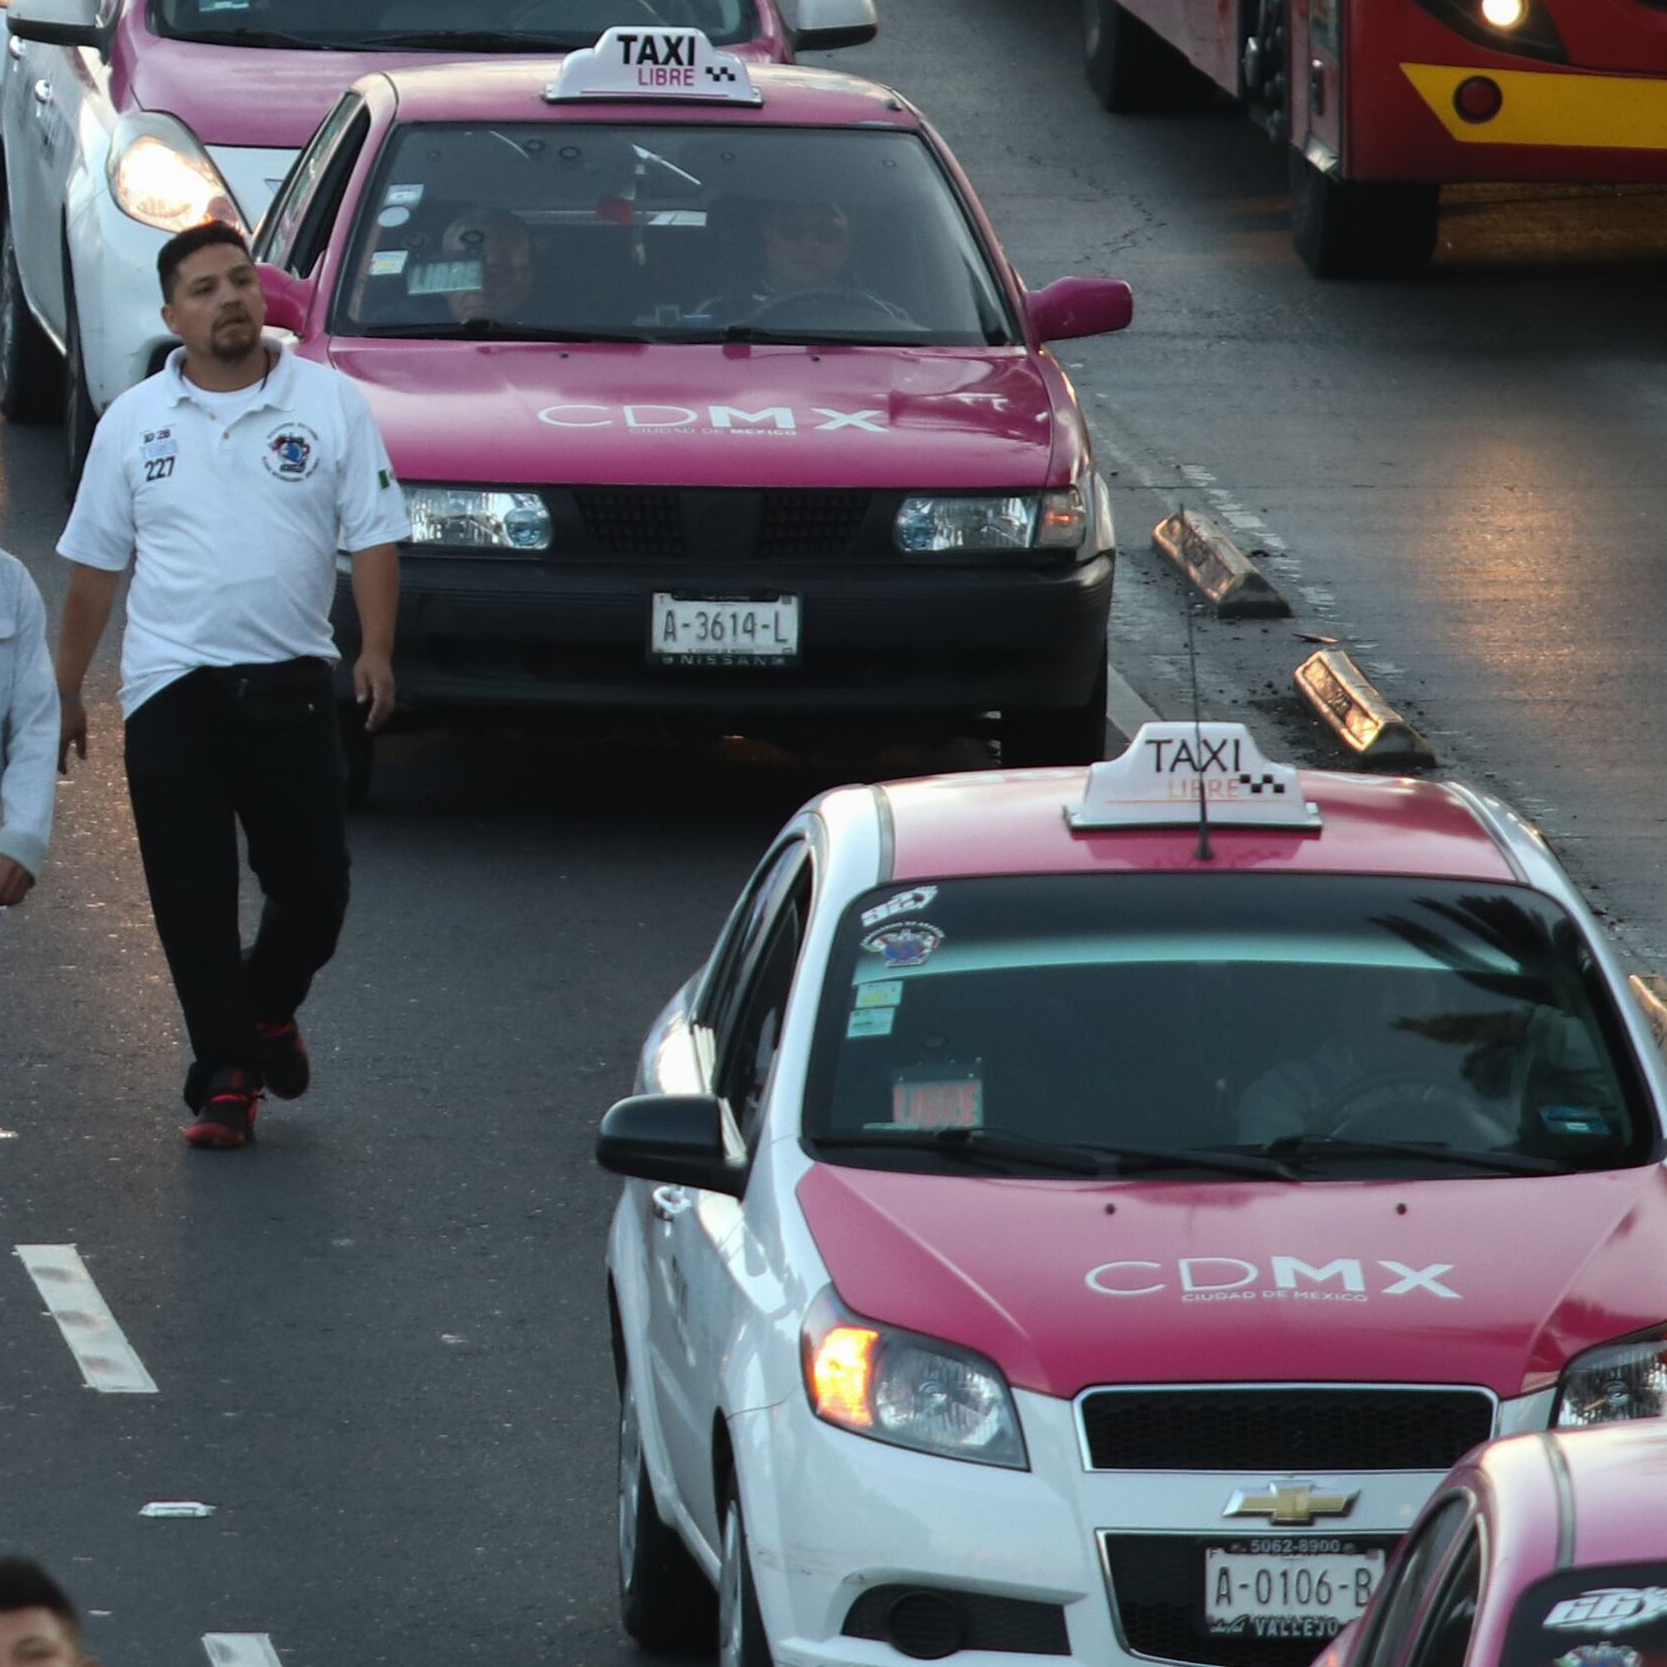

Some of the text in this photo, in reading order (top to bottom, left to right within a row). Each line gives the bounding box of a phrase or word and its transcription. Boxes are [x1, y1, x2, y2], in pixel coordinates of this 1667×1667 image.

[617, 34, 696, 66] TAXI
[637, 68, 695, 87] LIBRE
[537, 404, 890, 432] CDMX
[145, 455, 175, 482] 227
[663, 609, 788, 643] A-3614-L
[680, 654, 766, 665] NISSAN
[1145, 738, 1241, 773] TAXI
[1168, 778, 1240, 799] LIBRE
[1084, 1255, 1464, 1299] CDMX
[1181, 1290, 1256, 1303] CIUDAD
[1261, 1289, 1288, 1299] DE
[1250, 1539, 1341, 1553] 5062-8900
[1215, 1565, 1373, 1607] A-0106-B
[1253, 1614, 1340, 1637] VALLEJO
